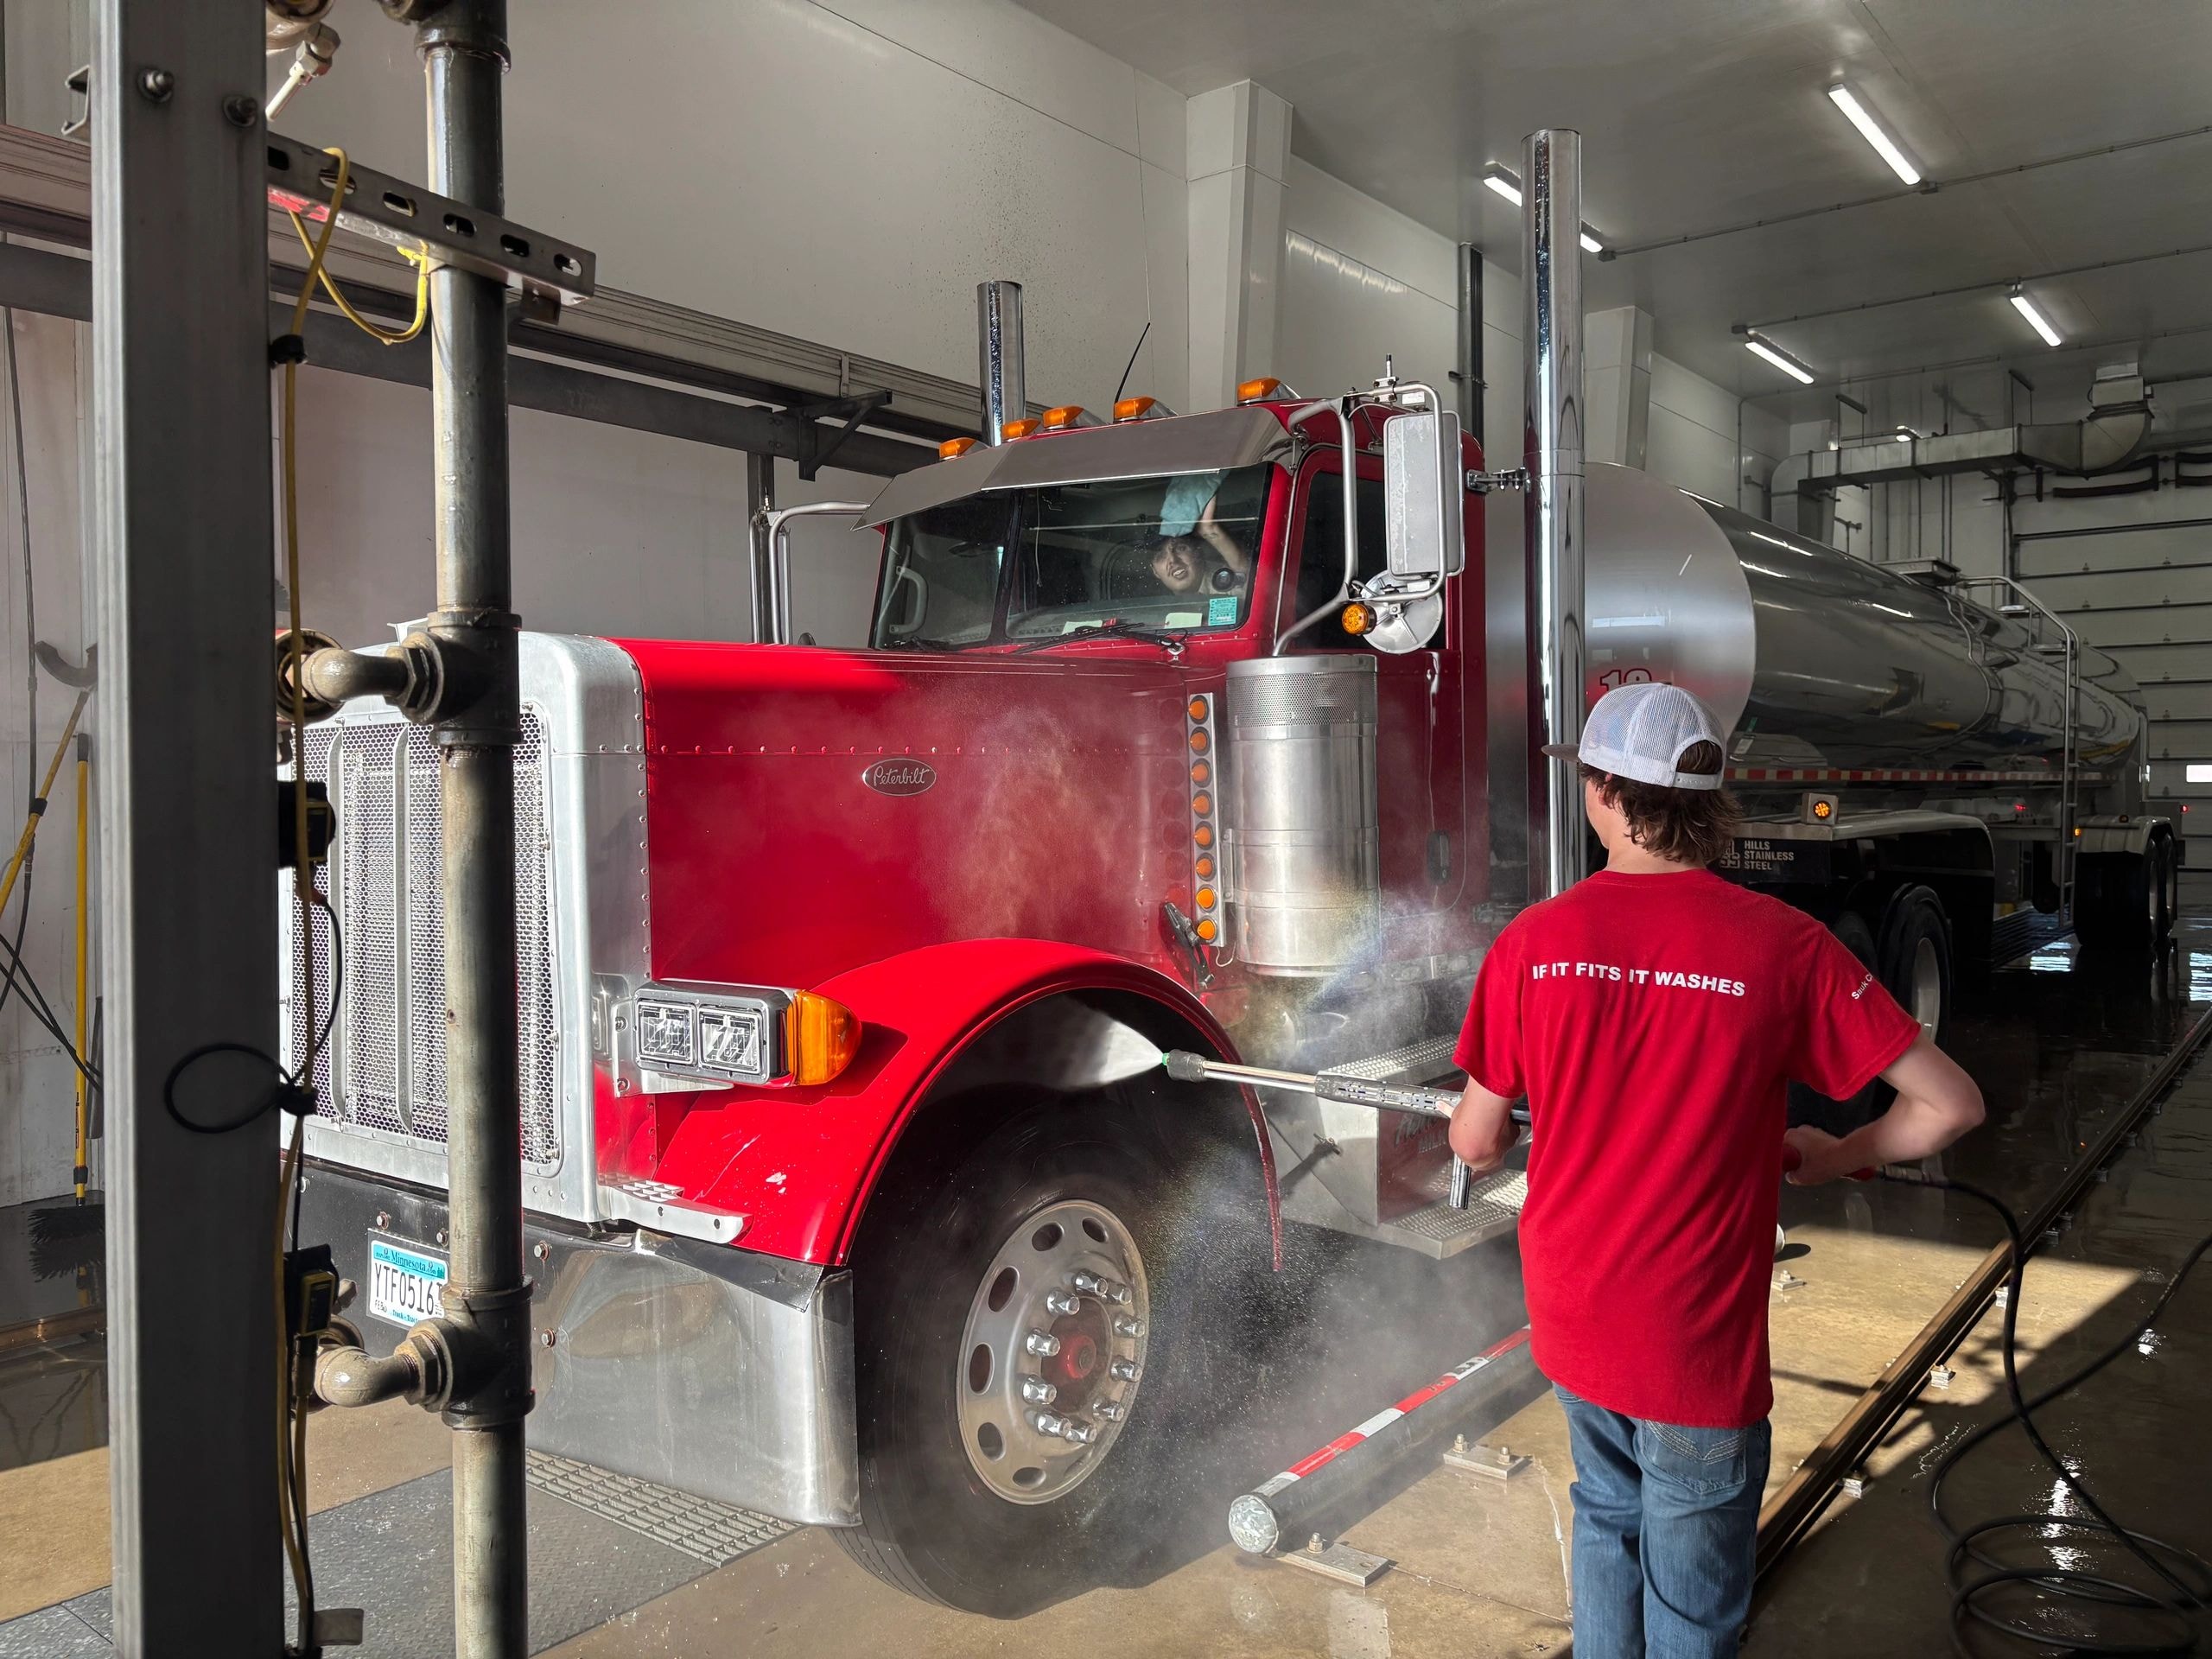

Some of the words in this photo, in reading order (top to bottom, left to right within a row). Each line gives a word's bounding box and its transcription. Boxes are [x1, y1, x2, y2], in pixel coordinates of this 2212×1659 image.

[873, 766, 930, 786] Peterbilt
[1744, 840, 1770, 850] HILLS
[1744, 850, 1795, 861] STAINLESS
[1744, 861, 1773, 871] STEEL
[1532, 963, 1548, 980] IF
[1552, 962, 1570, 977] IT
[1575, 962, 1622, 982] FITS
[1629, 969, 1649, 984] IT
[1654, 970, 1745, 997] WASHES
[1851, 981, 1869, 1000] Sauk
